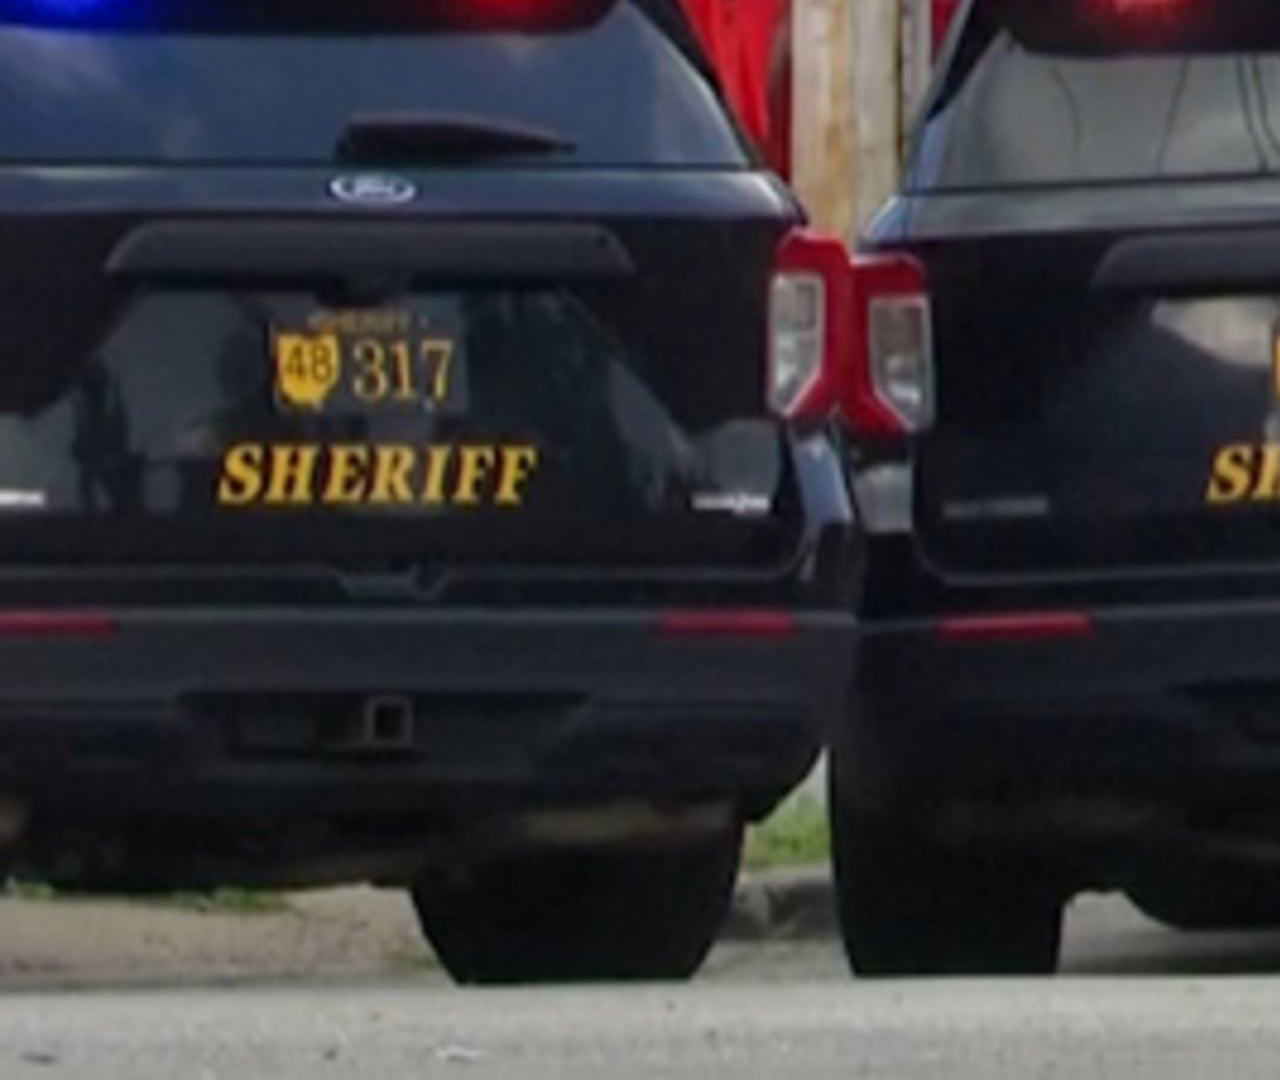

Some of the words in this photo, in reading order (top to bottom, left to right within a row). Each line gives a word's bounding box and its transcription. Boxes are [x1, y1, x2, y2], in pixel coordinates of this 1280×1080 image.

[284, 343, 333, 382] 48
[352, 338, 452, 400] 317
[217, 442, 538, 505] SHERIFF
